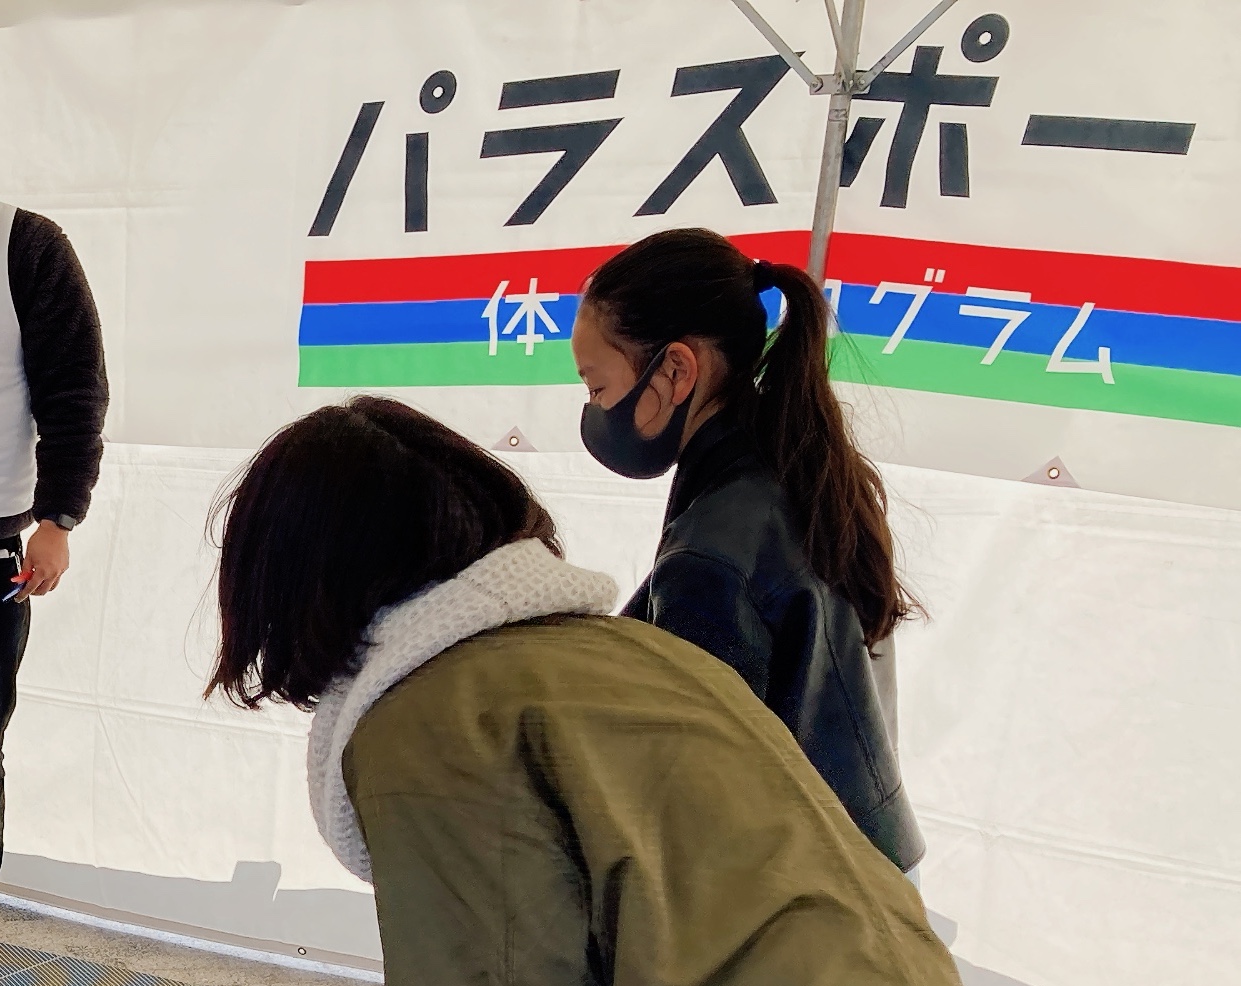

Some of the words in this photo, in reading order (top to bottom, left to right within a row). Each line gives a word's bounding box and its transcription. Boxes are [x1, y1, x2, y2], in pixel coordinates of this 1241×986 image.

[308, 13, 1197, 237] パラスポー
